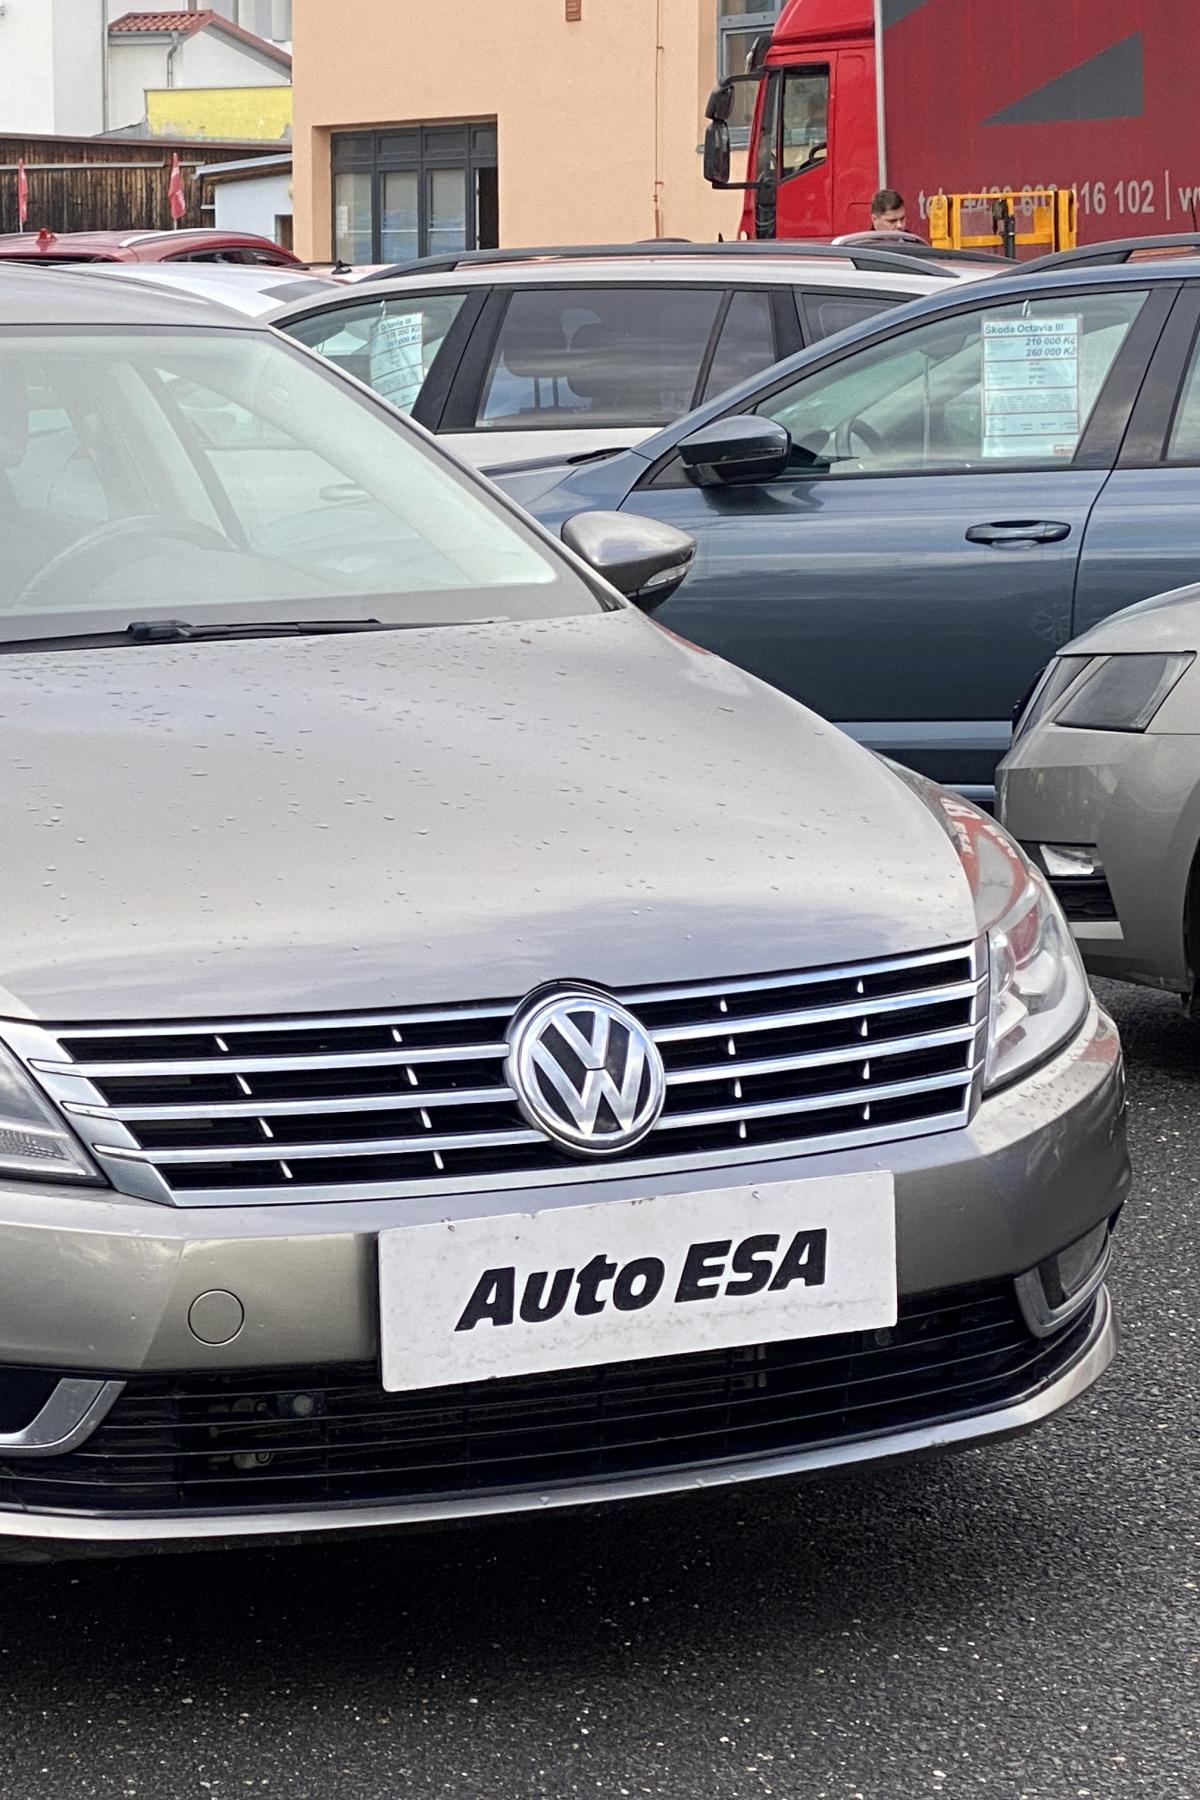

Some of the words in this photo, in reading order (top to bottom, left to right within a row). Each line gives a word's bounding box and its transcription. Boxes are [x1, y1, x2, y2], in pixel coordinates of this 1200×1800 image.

[1114, 180, 1154, 213] 102
[1017, 323, 1053, 333] Octavia
[1055, 323, 1064, 331] III
[1044, 337, 1061, 345] 000
[1044, 348, 1062, 356] 000
[454, 1253, 665, 1332] Auto
[674, 1227, 828, 1304] ESA
